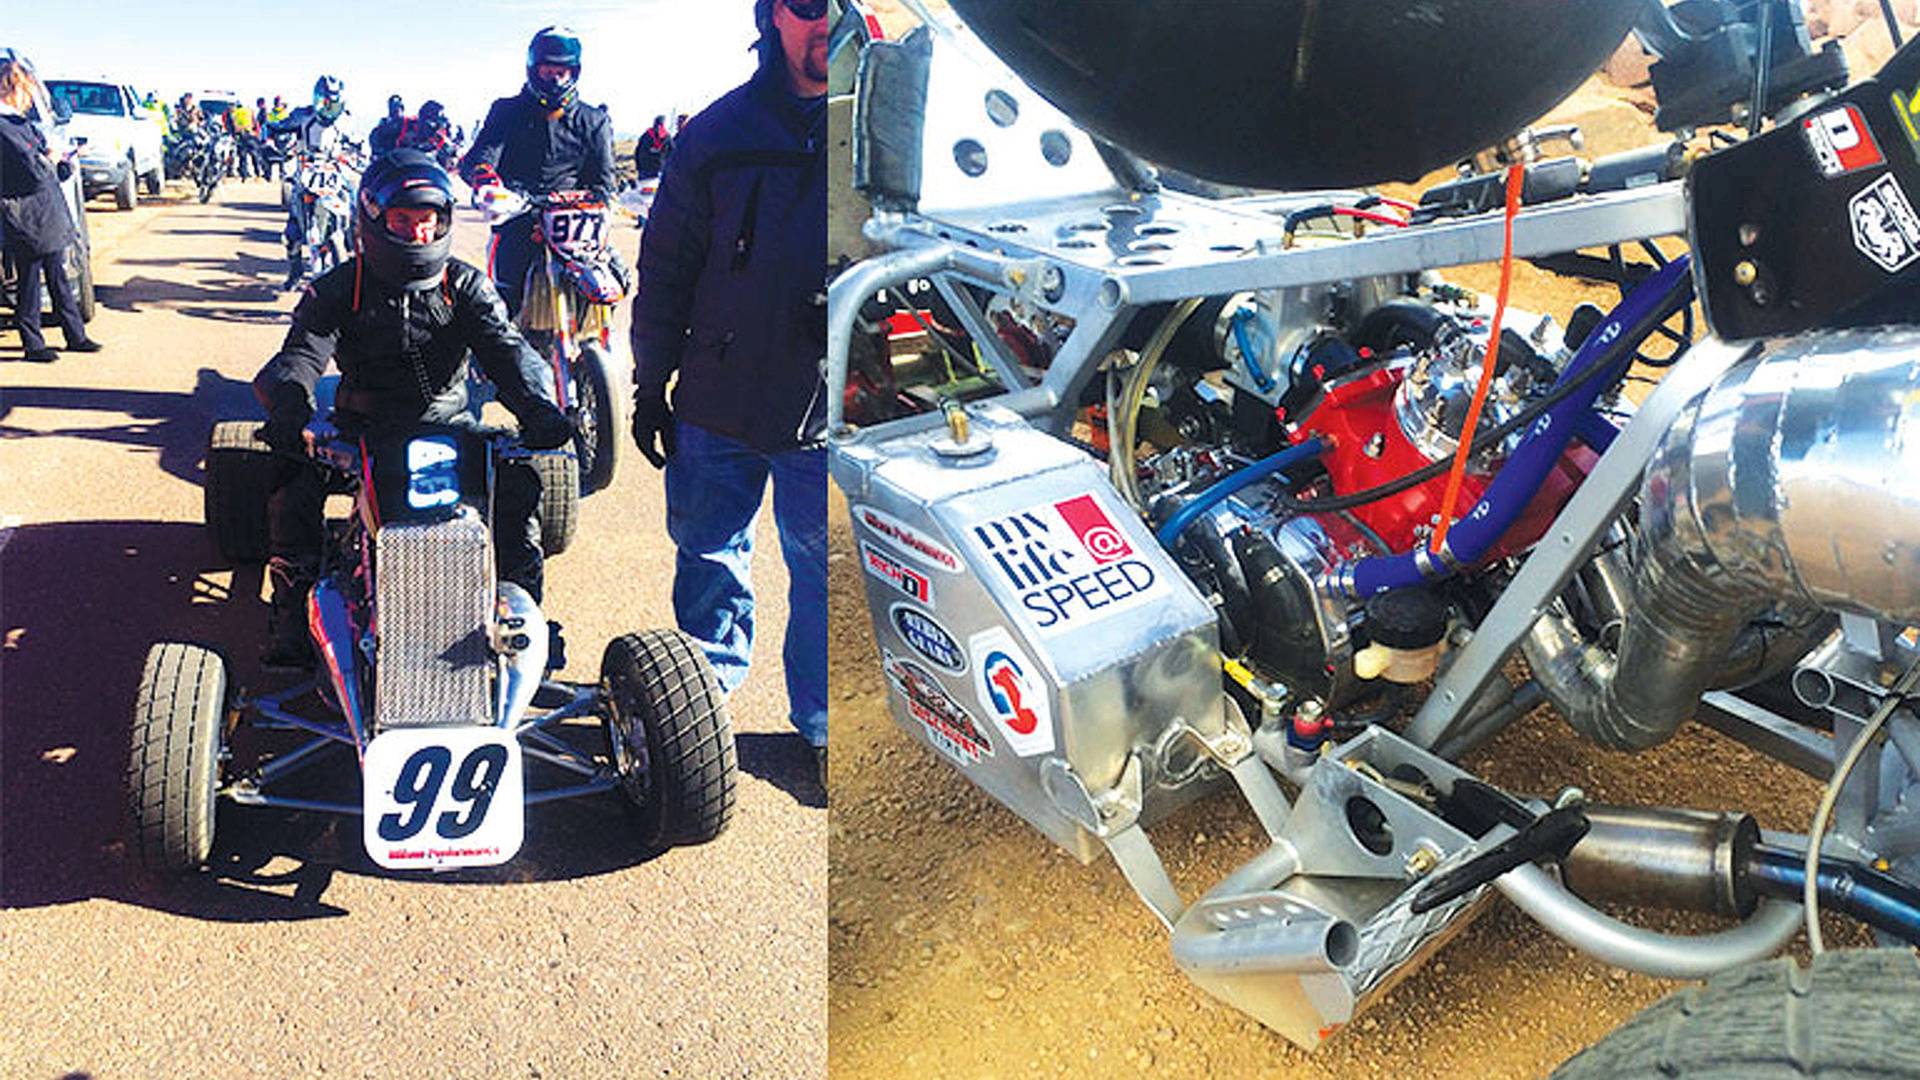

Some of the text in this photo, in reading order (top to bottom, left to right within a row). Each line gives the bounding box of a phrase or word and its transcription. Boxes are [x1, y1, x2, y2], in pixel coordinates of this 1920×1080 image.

[974, 512, 1049, 550] my
[992, 540, 1075, 590] life
[1022, 560, 1155, 627] SPEED
[377, 743, 509, 842] 99
